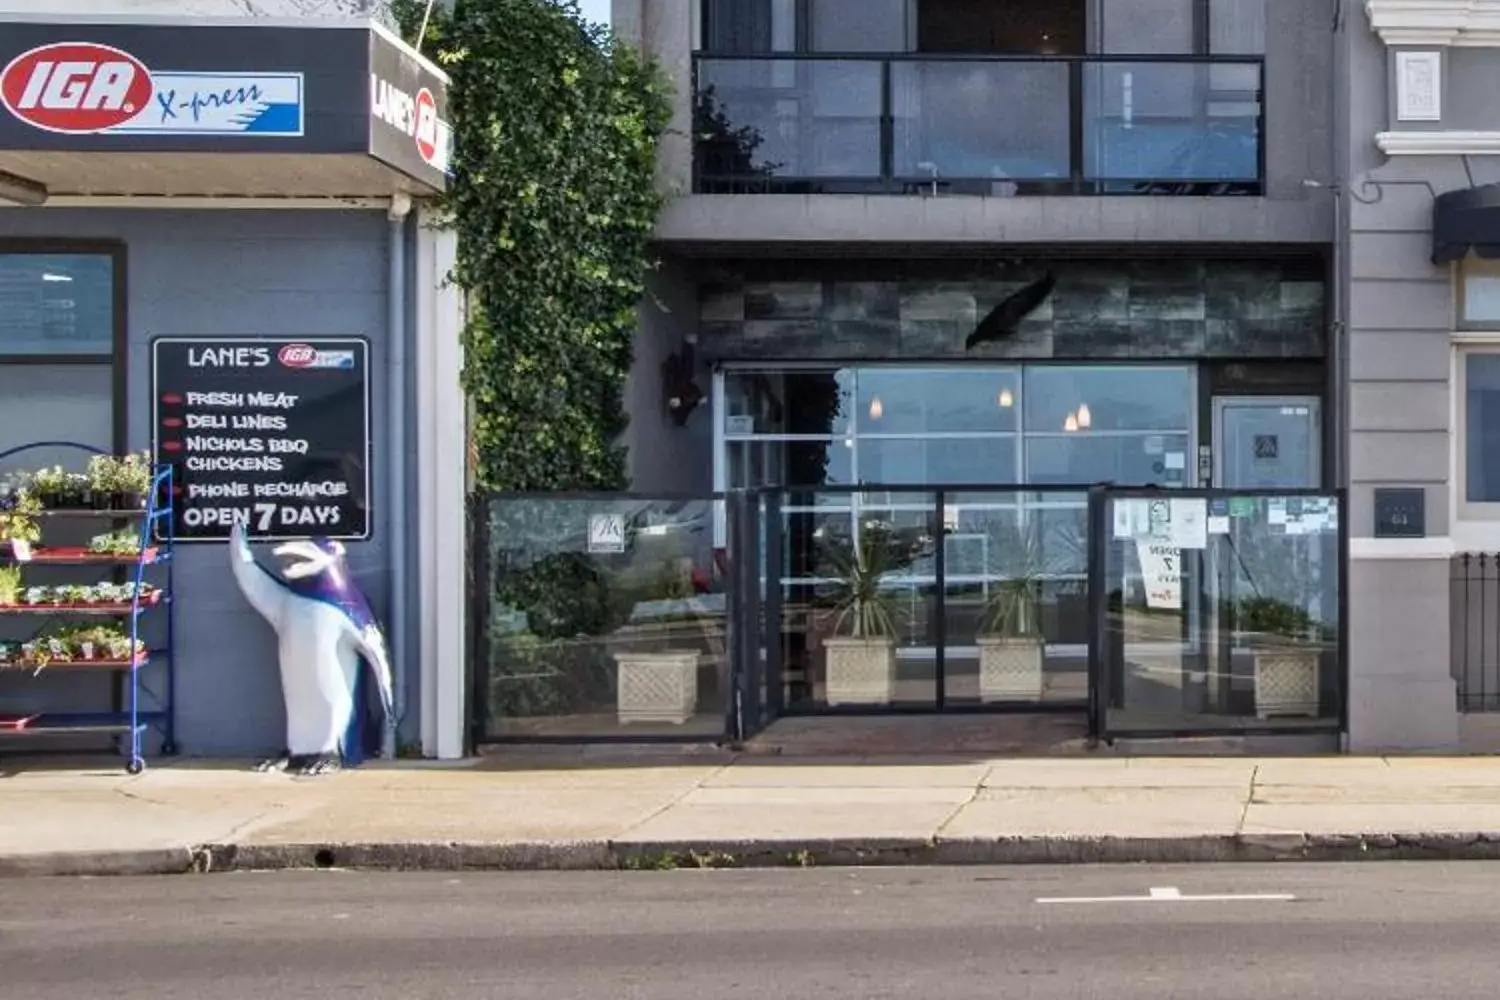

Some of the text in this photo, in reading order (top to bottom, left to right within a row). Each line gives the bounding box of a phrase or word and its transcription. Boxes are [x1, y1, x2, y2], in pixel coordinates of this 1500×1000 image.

[18, 61, 136, 110] IGA
[157, 84, 262, 123] X-press
[188, 347, 270, 367] LANE'S
[186, 391, 298, 408] FRESH MEAT
[186, 414, 287, 430] DELI LINES
[186, 436, 309, 455] NICHOLS BBQ
[186, 456, 283, 471] CHICKENS
[188, 481, 349, 498] PHONE RECHARGE
[183, 503, 341, 531] OPEN 7 DAYS
